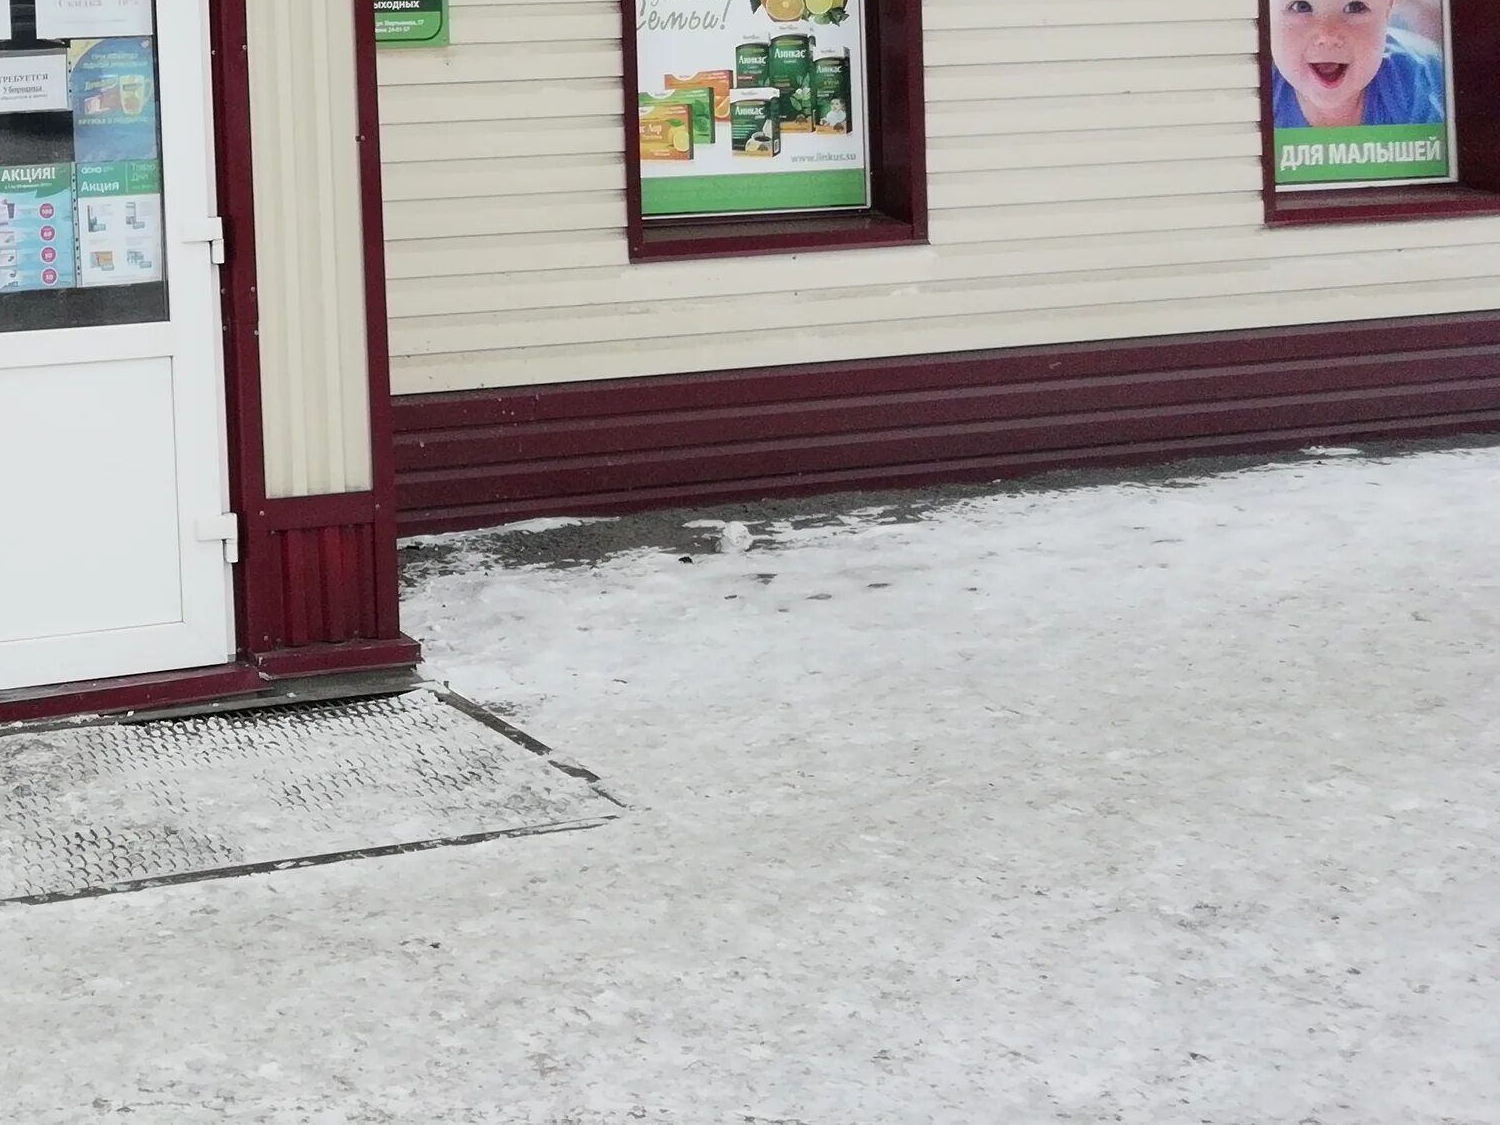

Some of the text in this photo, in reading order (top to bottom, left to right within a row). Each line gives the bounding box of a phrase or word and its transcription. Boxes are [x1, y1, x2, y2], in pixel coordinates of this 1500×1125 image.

[1280, 136, 1442, 172] ДЛЯ МАЛЫШЕЙ
[1, 167, 56, 183] АКЦИЯ!
[81, 181, 119, 193] Акция
